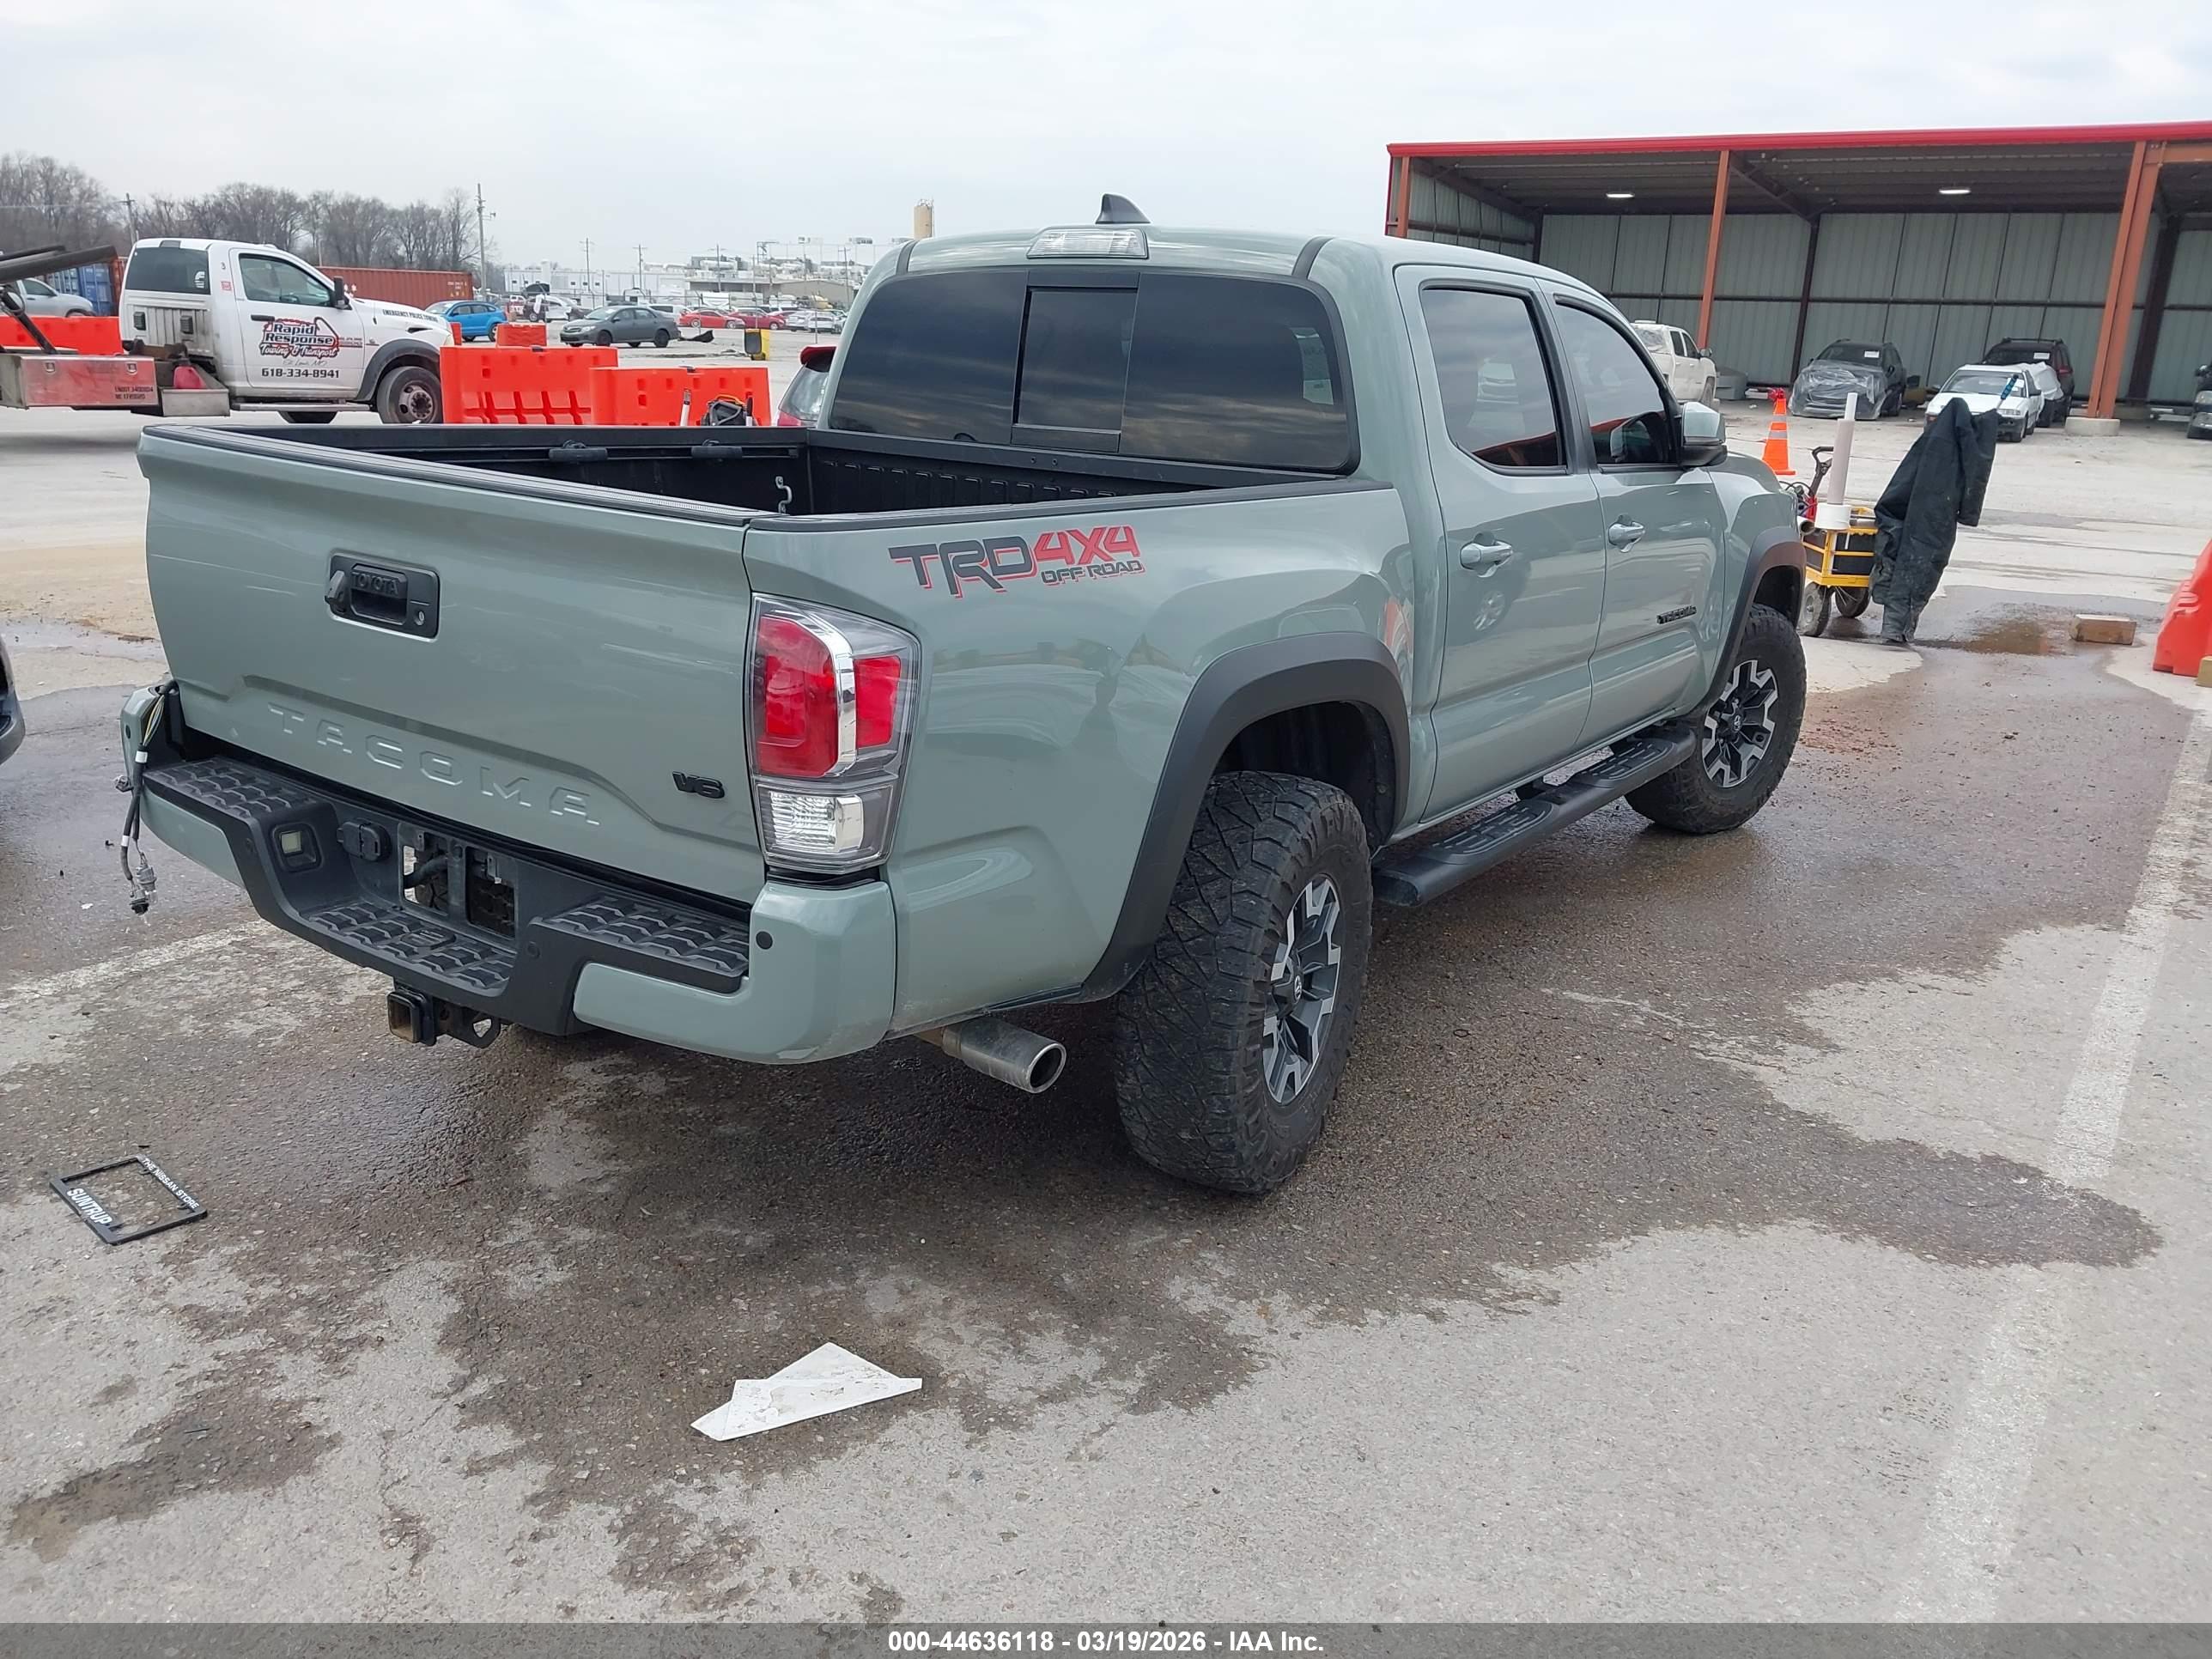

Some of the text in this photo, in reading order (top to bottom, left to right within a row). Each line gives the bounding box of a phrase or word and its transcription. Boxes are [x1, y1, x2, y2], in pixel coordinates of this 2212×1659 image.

[264, 332, 333, 344] Response
[273, 324, 314, 335] Rapid
[259, 343, 290, 357] Towing
[301, 345, 338, 358] Transport
[261, 368, 340, 379] 618-334-8941
[888, 535, 1036, 599] TRD
[1041, 559, 1146, 586] OFF ROAD
[350, 571, 400, 596] TOYOTA
[267, 701, 600, 825] TACOMA
[672, 771, 726, 799] V6
[142, 1157, 200, 1210] THE NISSAN STORE
[66, 1188, 113, 1226] SUNTRUP
